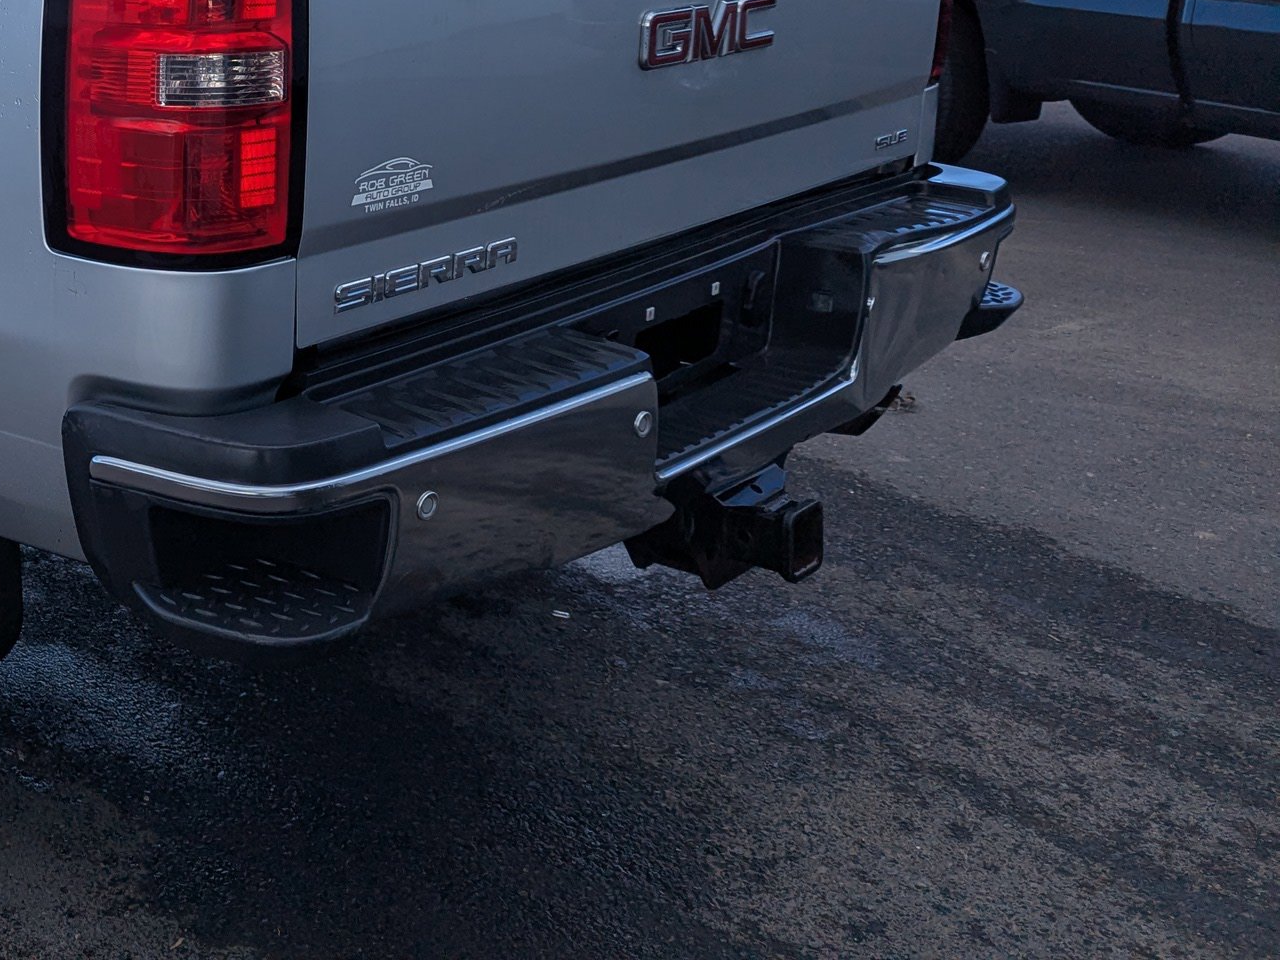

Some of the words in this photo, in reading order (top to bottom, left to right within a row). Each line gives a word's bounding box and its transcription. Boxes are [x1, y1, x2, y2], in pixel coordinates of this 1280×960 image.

[874, 129, 908, 151] SLE
[359, 178, 386, 192] ROB
[389, 169, 429, 186] GREEN
[365, 189, 389, 201] AUTO
[390, 182, 421, 196] GROUP
[364, 201, 384, 213] TWIN
[385, 196, 410, 209] FALLS,
[411, 194, 420, 203] ID
[333, 237, 518, 315] SIERRA
